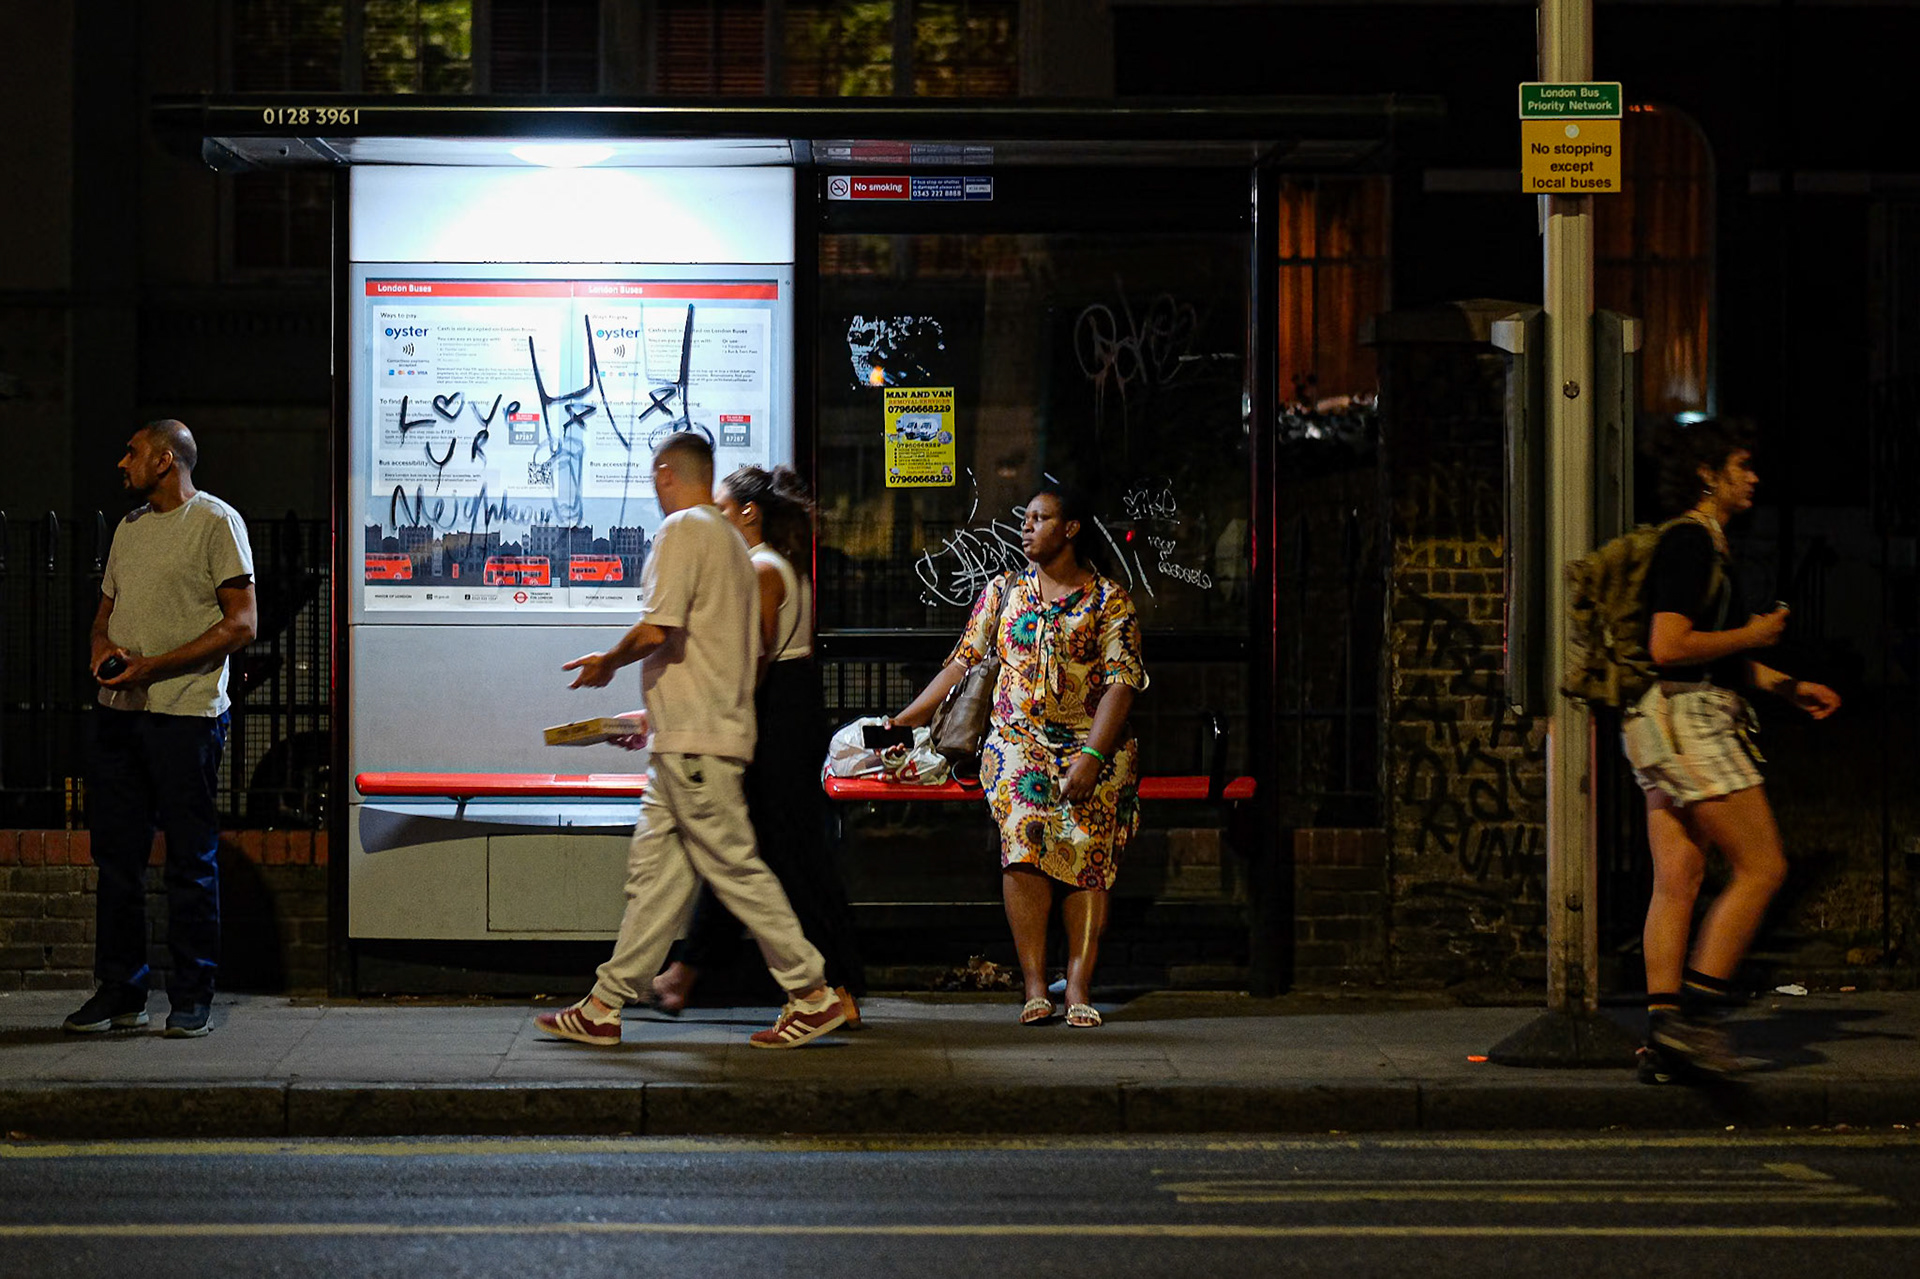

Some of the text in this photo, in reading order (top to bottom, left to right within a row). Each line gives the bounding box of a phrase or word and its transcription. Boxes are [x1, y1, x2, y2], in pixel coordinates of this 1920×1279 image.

[1540, 87, 1600, 98] London Bus
[1527, 100, 1613, 112] Priority Network
[263, 107, 359, 125] 0128 3961
[1531, 142, 1612, 157] No stopping
[1550, 161, 1594, 174] except
[853, 182, 903, 193] No smoking
[1532, 176, 1612, 188] local buses
[377, 284, 432, 293] London Buses
[588, 285, 643, 294] London Buses
[384, 325, 430, 340] oyster
[596, 327, 641, 341] oyster
[931, 390, 952, 398] VAN
[888, 405, 952, 413] 07960668229
[391, 459, 429, 468] accessibility
[889, 475, 953, 484] 07960668229
